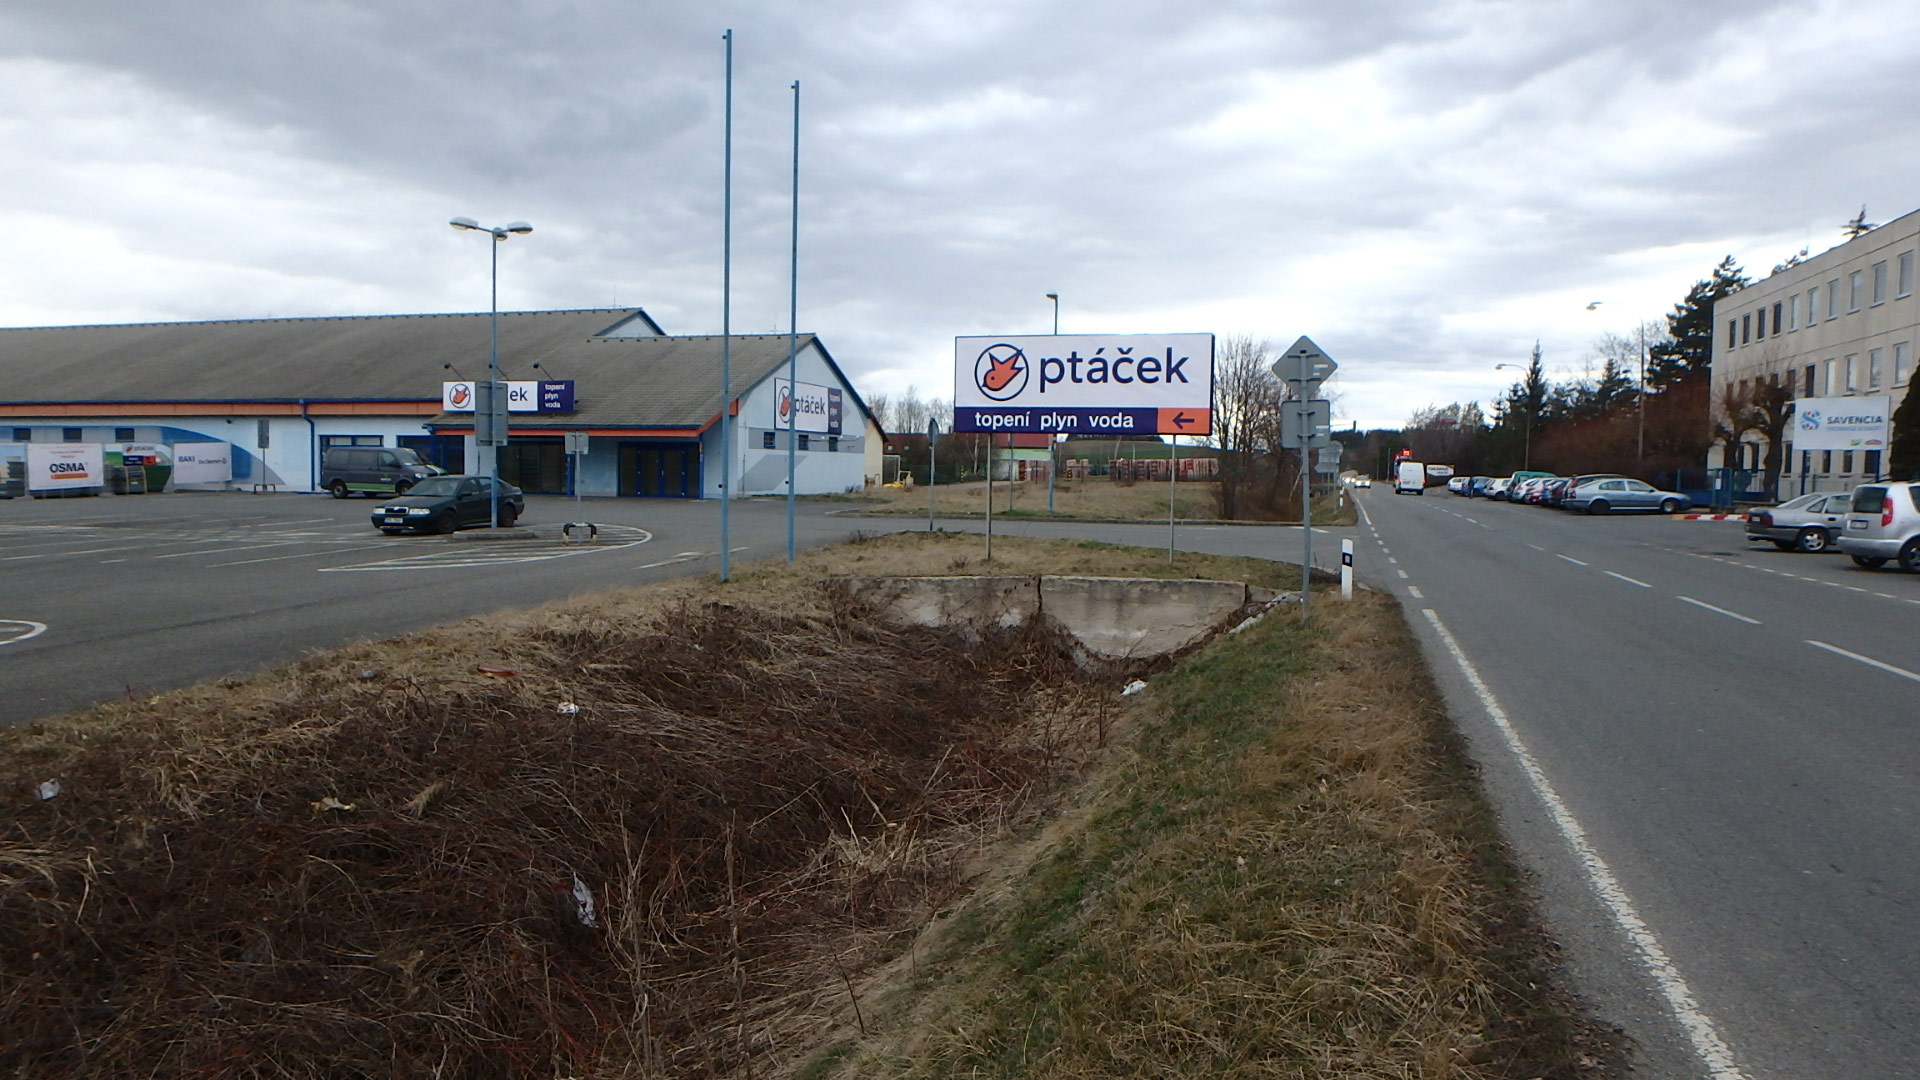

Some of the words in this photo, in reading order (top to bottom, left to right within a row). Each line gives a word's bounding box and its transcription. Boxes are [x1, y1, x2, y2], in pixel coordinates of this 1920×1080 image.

[1040, 347, 1190, 393] ptáček
[510, 387, 528, 401] ek
[975, 411, 1031, 429] topení
[1040, 412, 1078, 431] plyn
[1088, 412, 1134, 428] voda
[1827, 416, 1883, 424] SAVENCIA
[49, 463, 86, 473] OSMA
